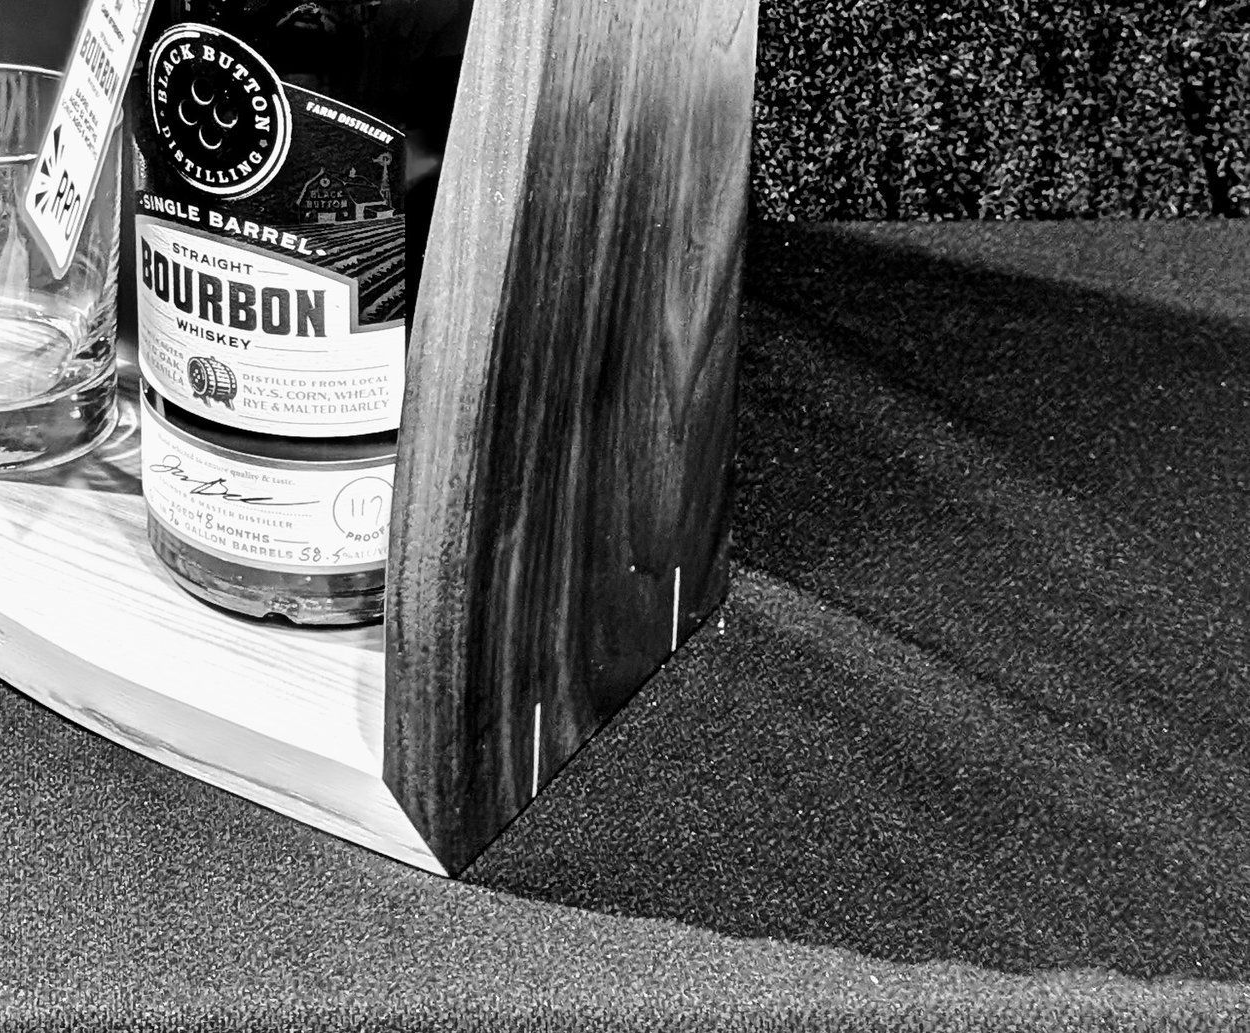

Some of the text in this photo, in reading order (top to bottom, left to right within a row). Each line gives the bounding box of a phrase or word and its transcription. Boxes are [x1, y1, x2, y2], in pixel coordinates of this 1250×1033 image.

[79, 29, 120, 104] BOURBON
[158, 44, 271, 132] BLACK BUTTON
[306, 101, 394, 144] FARM DISTILLERY
[162, 126, 263, 183] DISTILLING
[51, 169, 81, 241] RPO
[310, 190, 343, 199] BLACK
[143, 194, 312, 256] SINGLE BARREL
[172, 242, 254, 275] STRAIGHT
[141, 236, 327, 338] BOURBON
[176, 317, 252, 350] WHISKEY
[242, 373, 388, 388] DISTILLED FROM LOCAL
[243, 384, 389, 402] N.Y.S. CORN, WHEAT,
[243, 397, 390, 414] RYE & MALTED BARLEY
[230, 469, 259, 483] quality
[196, 510, 214, 529] 48
[216, 522, 270, 544] MONTHS
[238, 513, 293, 529] DISTILLER
[345, 524, 386, 542] PROOF
[185, 522, 227, 546] GALLON
[232, 540, 294, 560] BARRELS
